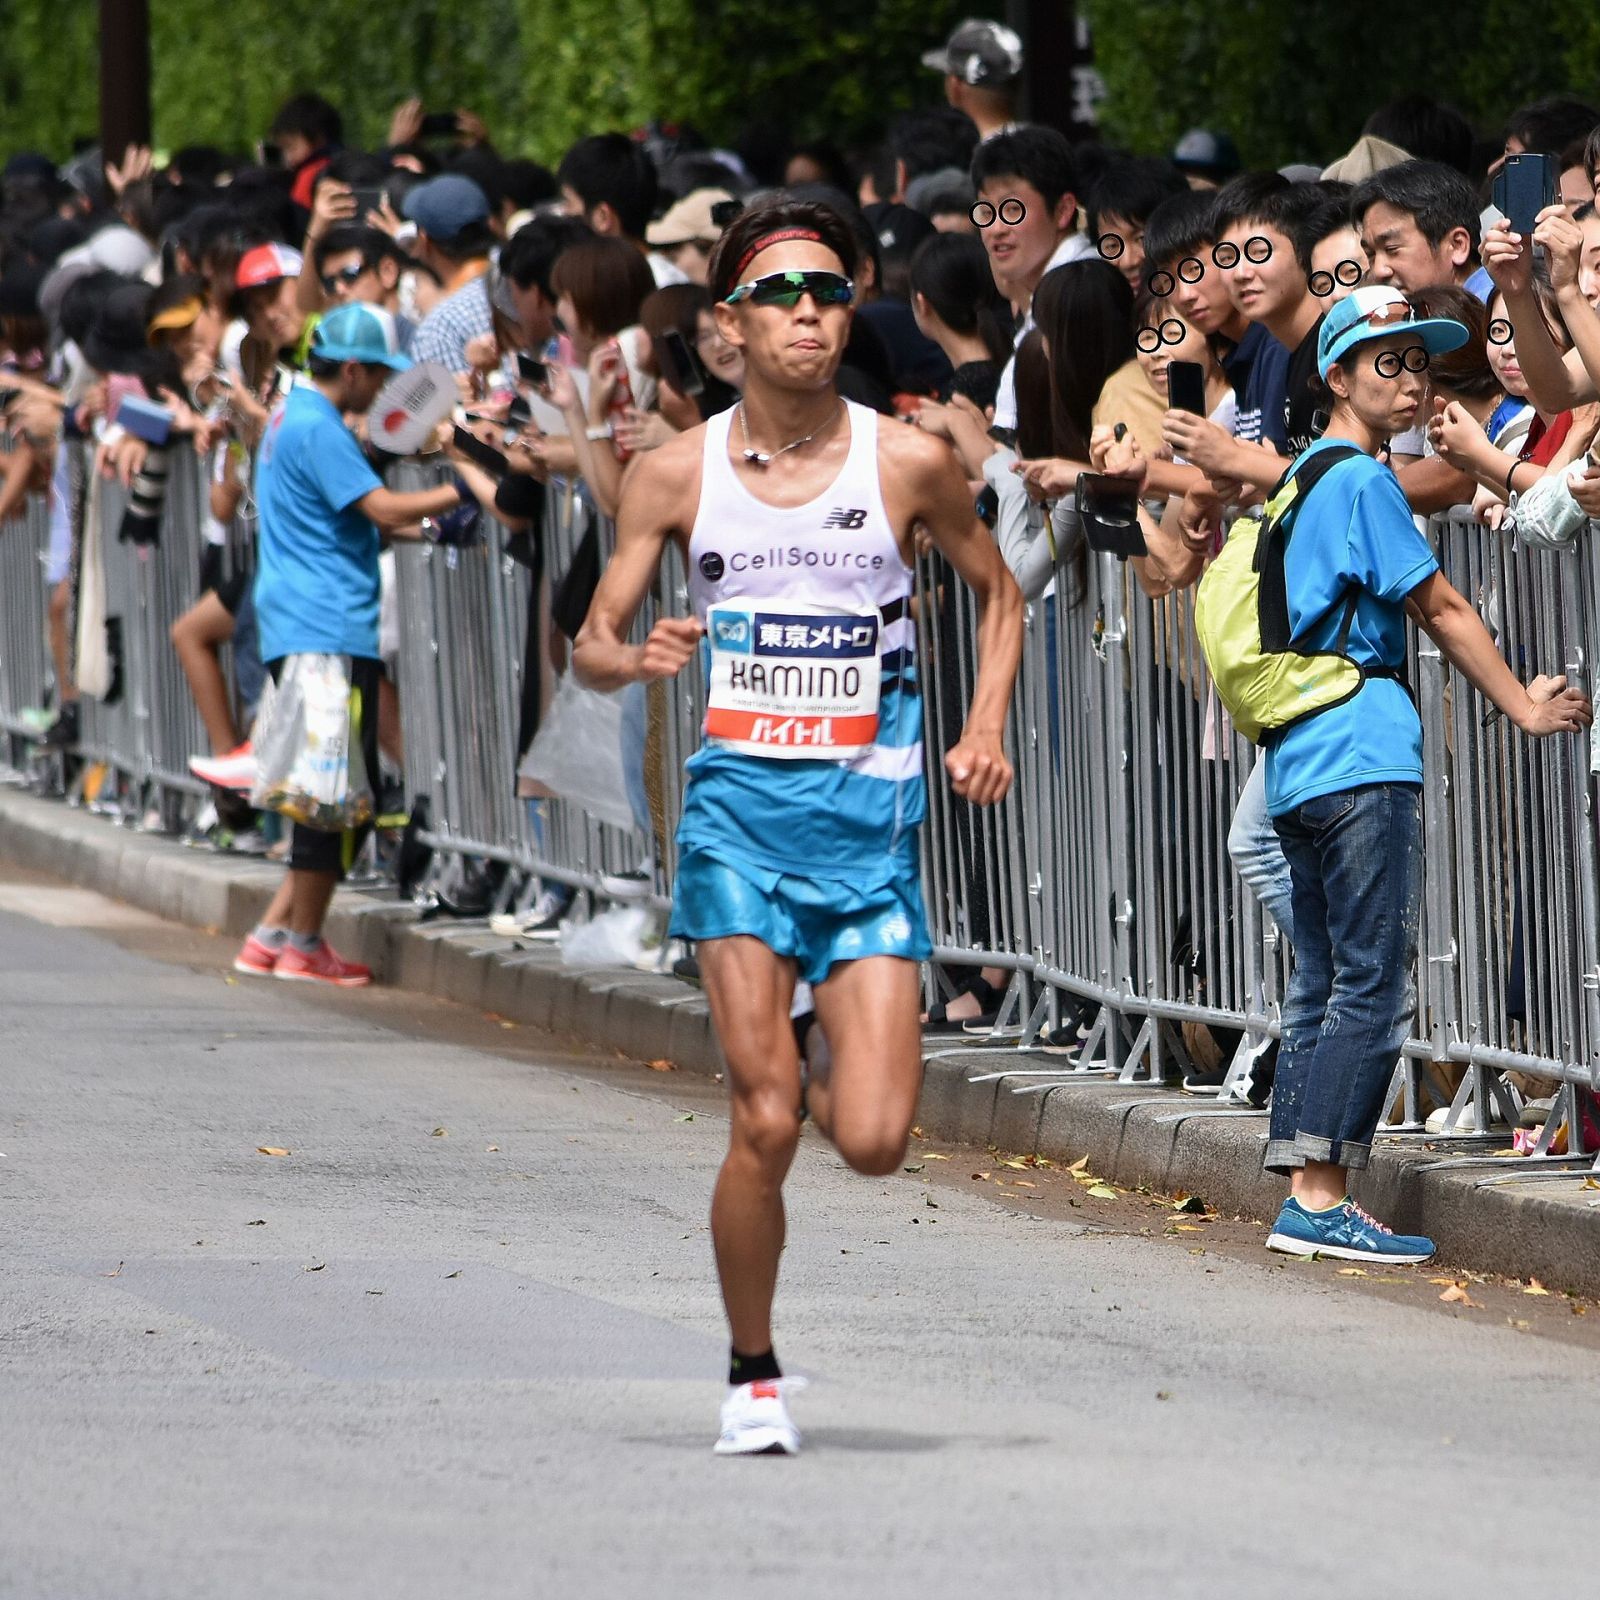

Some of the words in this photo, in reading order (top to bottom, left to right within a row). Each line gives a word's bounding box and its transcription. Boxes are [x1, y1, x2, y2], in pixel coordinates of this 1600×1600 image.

[730, 547, 884, 572] CellSource
[759, 623, 874, 649] 東京メトロ
[731, 660, 860, 697] KAMINO
[750, 717, 836, 745] バイトル
